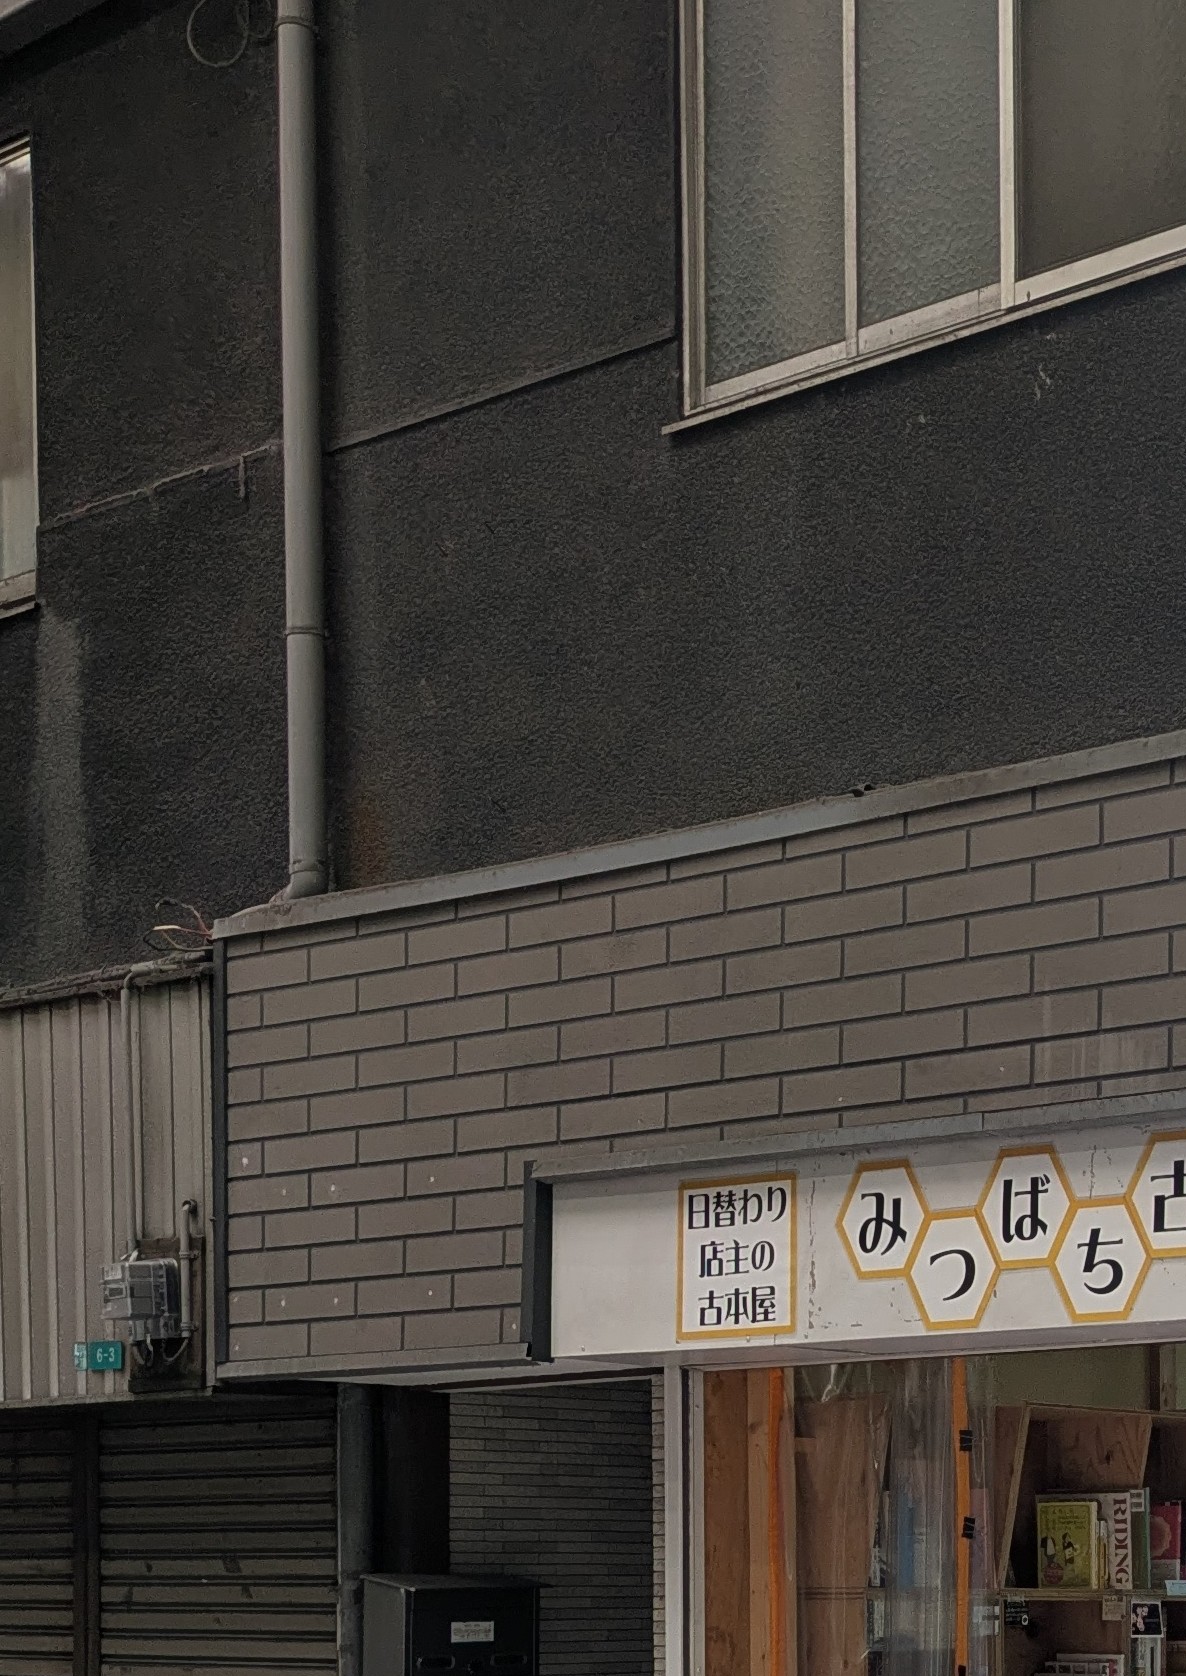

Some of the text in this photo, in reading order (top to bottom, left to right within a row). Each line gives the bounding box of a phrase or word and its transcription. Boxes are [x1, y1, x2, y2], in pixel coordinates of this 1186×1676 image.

[687, 1186, 787, 1230] 日替わり
[699, 1240, 775, 1278] 店主の
[699, 1286, 776, 1328] 古本屋
[96, 1347, 115, 1363] 6-3
[1113, 1497, 1130, 1584] RIDING
